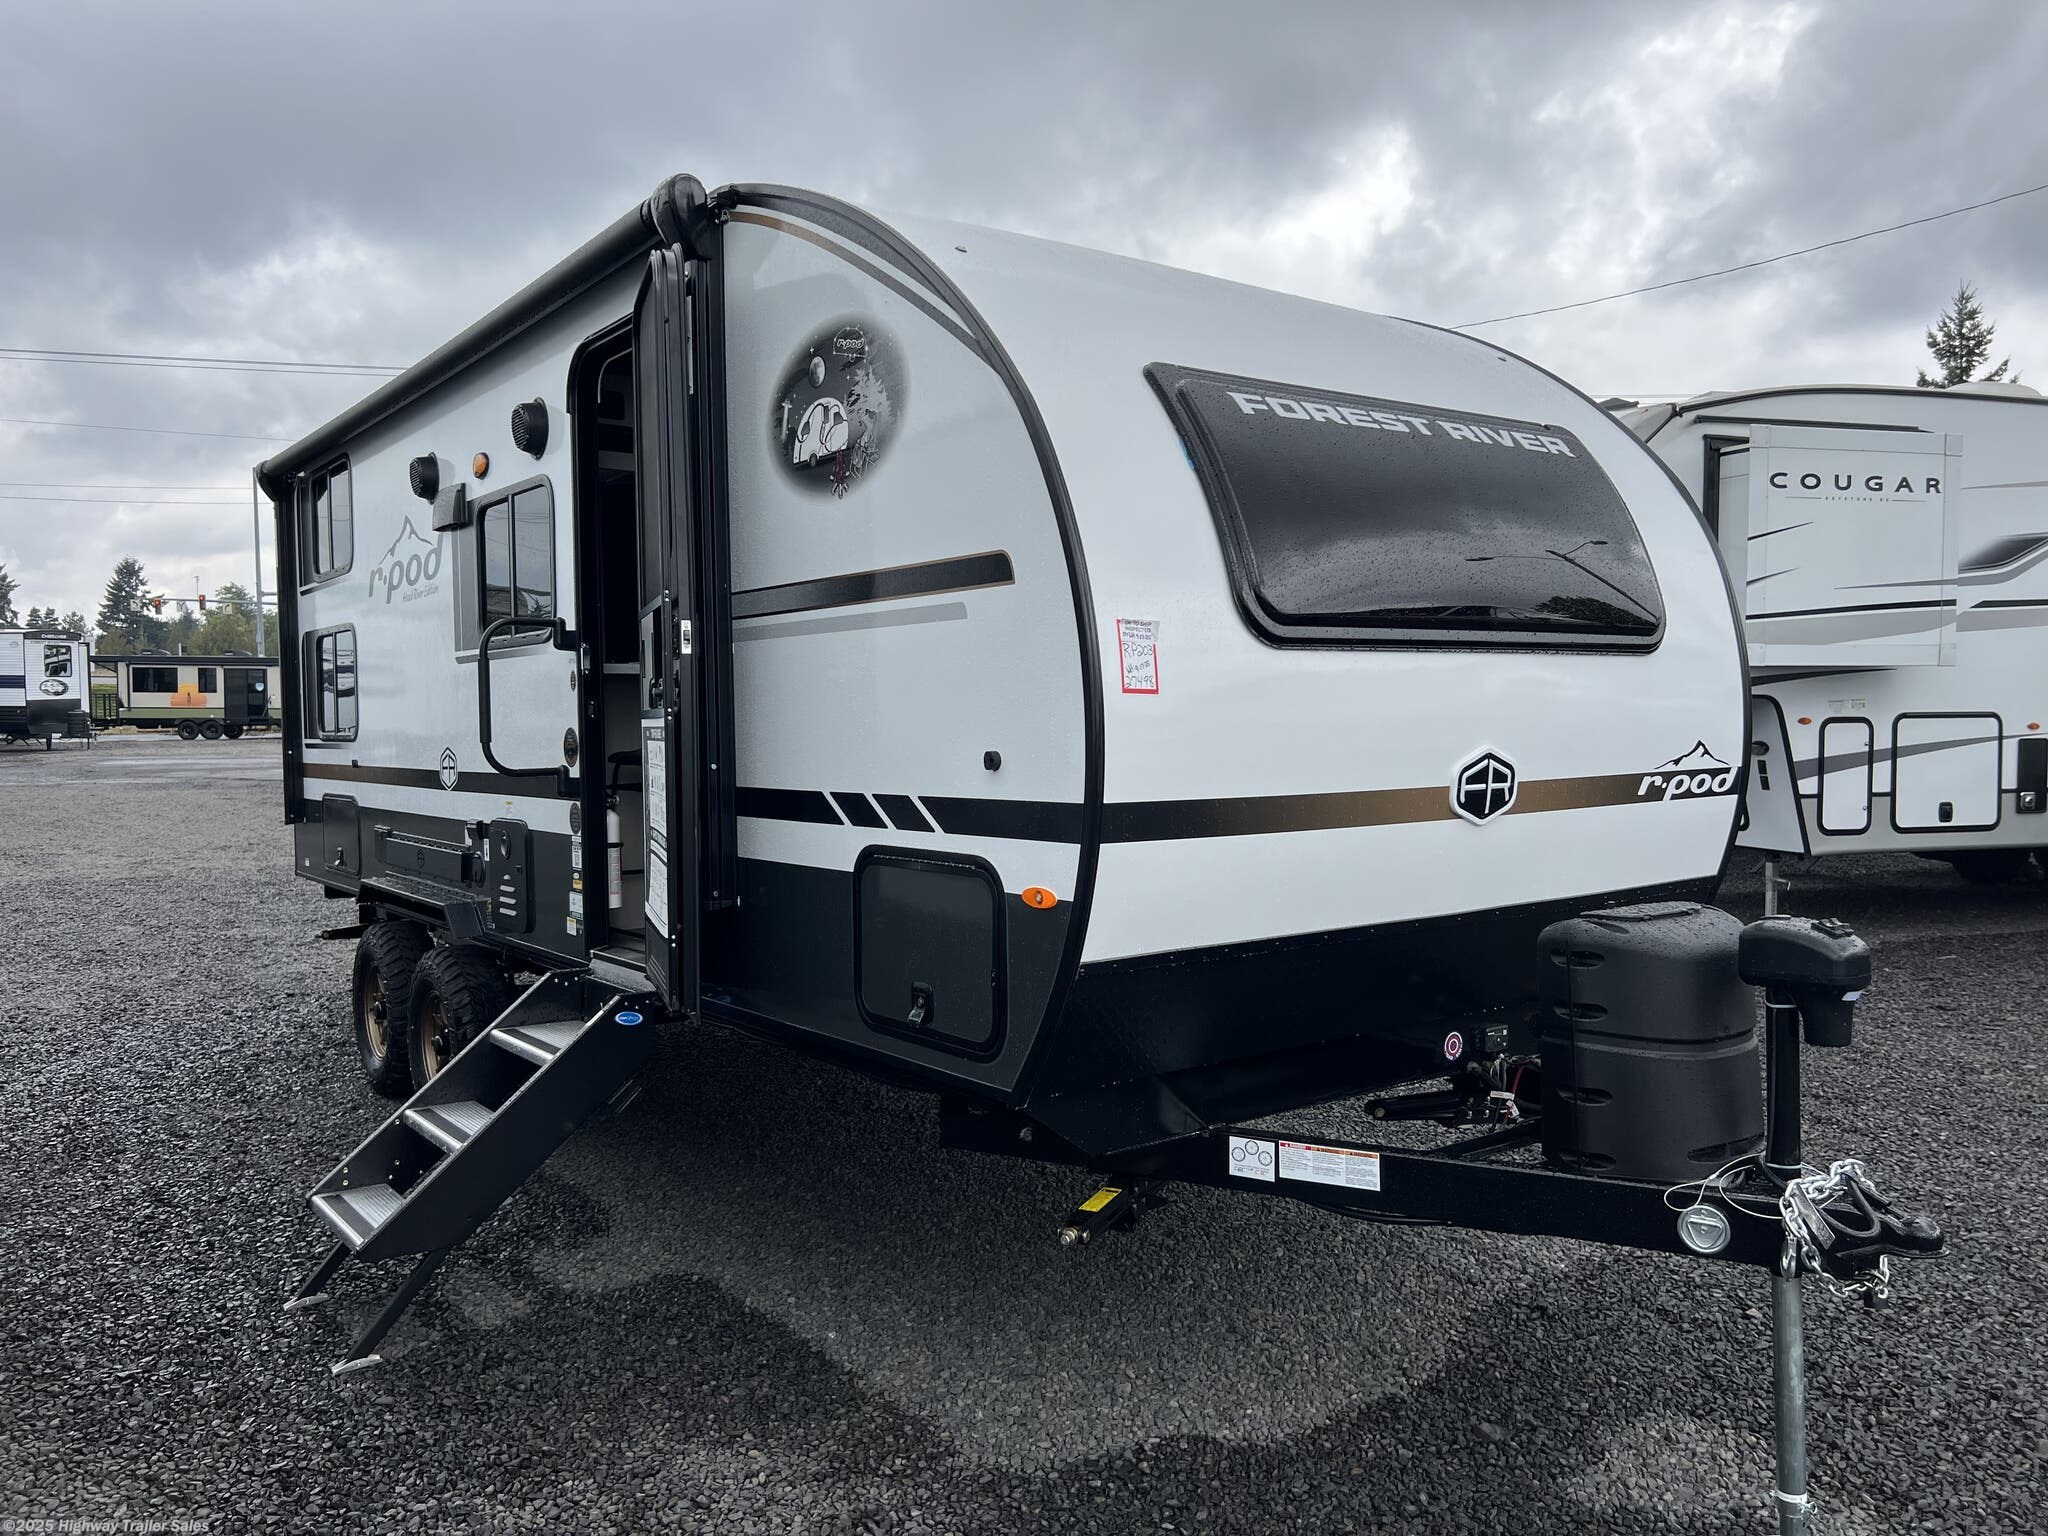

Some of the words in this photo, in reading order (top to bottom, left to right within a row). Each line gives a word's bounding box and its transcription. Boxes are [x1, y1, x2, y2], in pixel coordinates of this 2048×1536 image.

[1226, 391, 1434, 436] FOREST
[1435, 420, 1577, 459] RIVER
[1769, 472, 1942, 494] COUGAR
